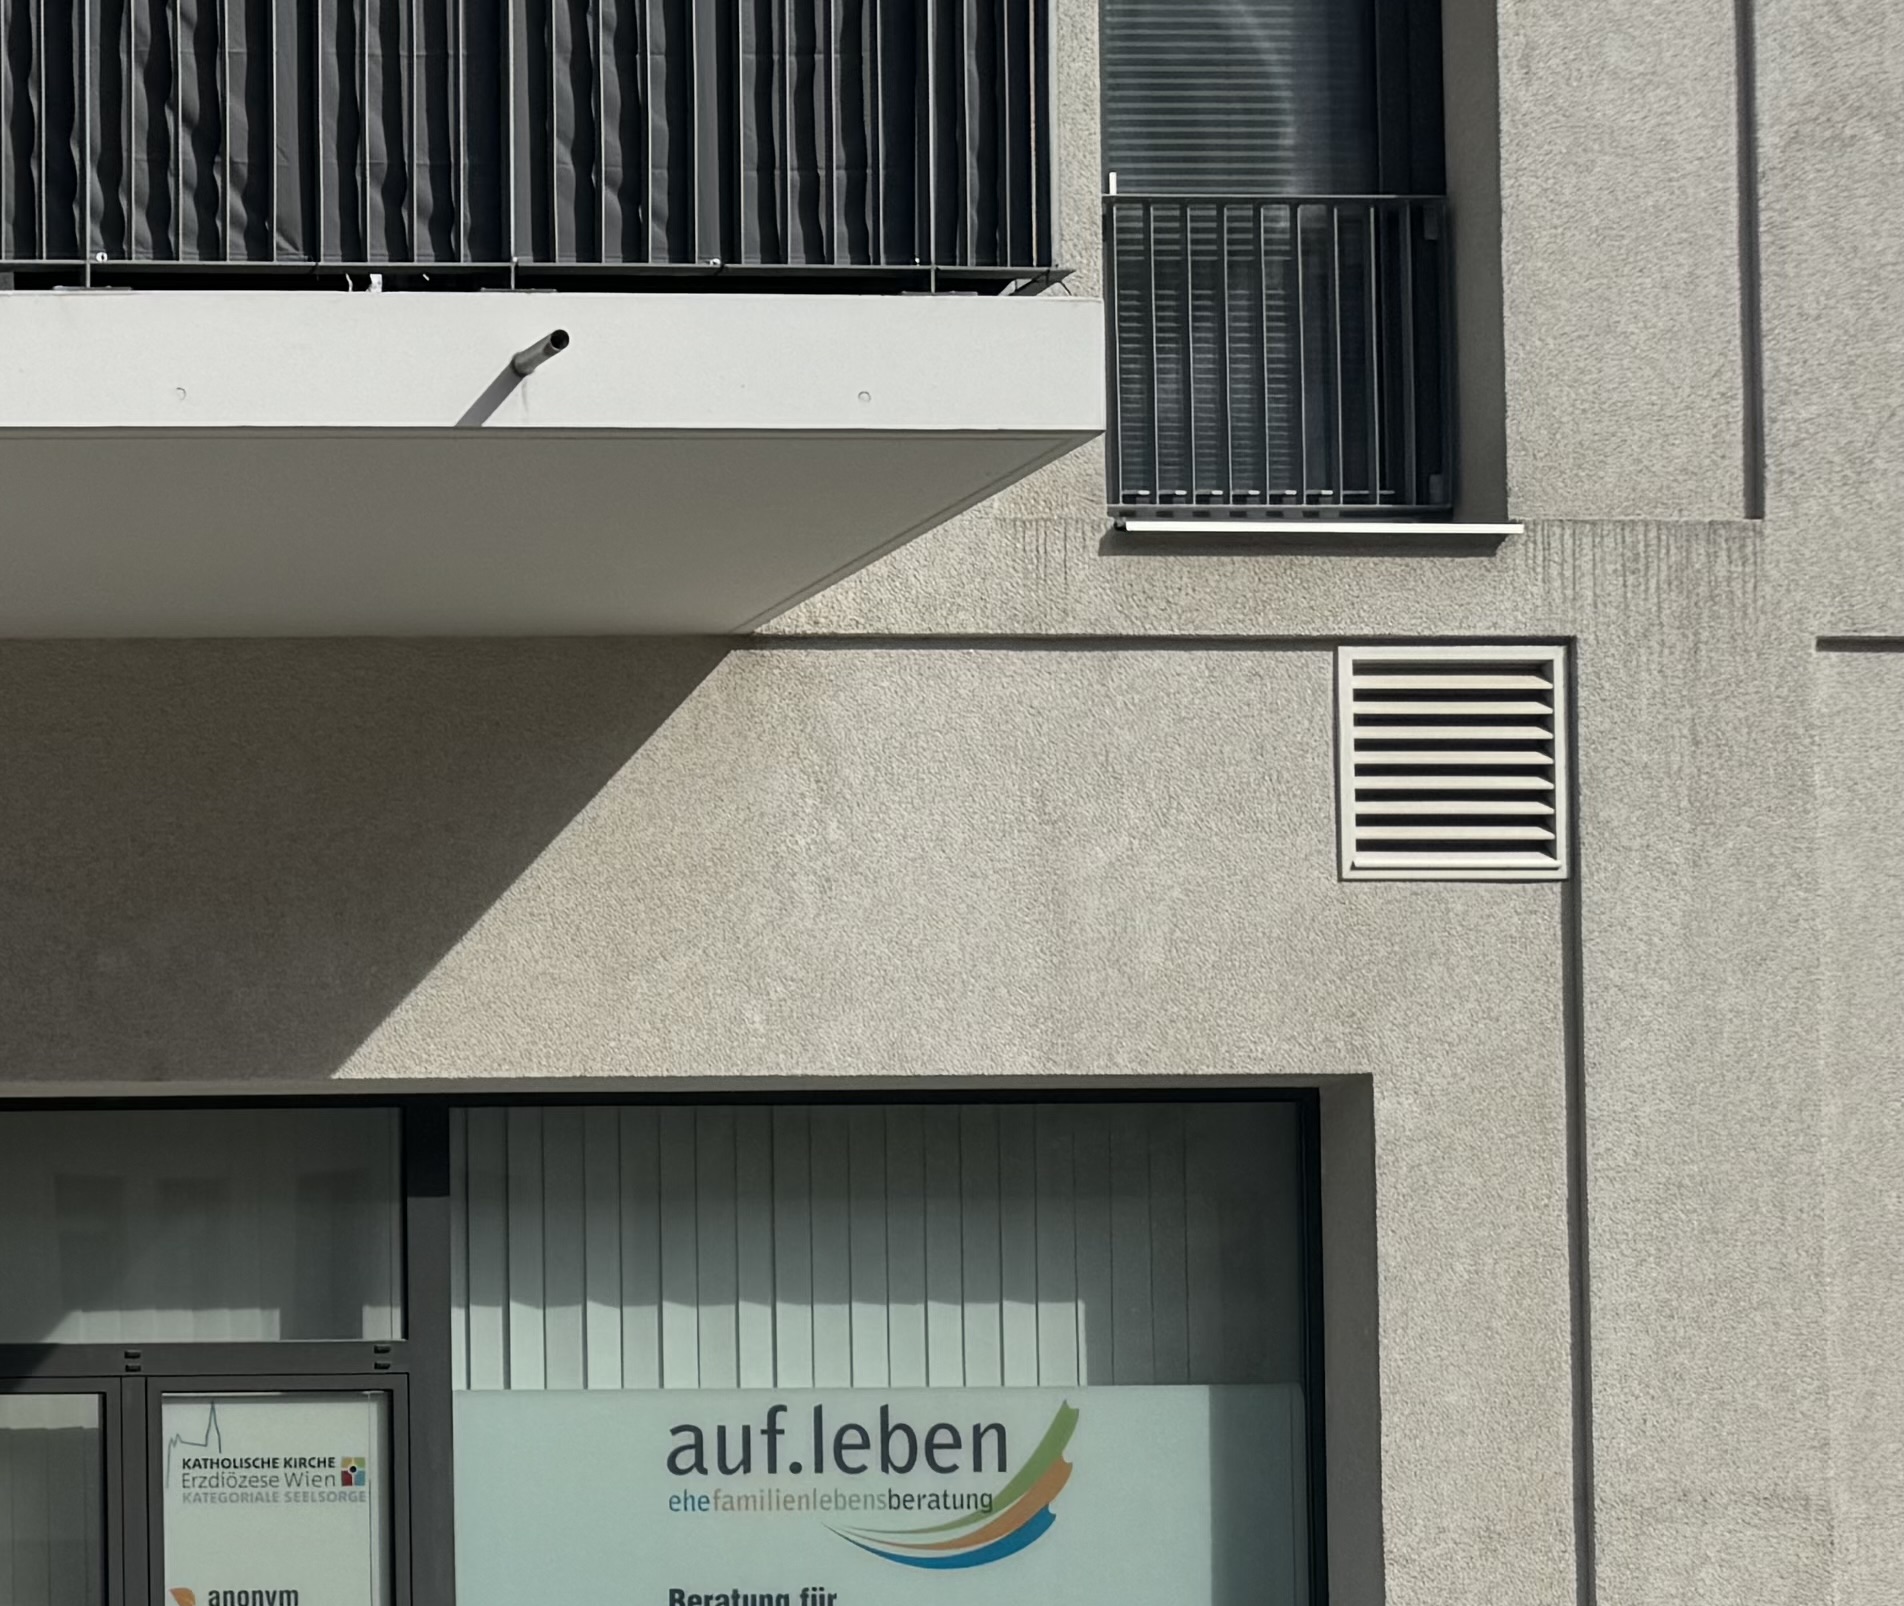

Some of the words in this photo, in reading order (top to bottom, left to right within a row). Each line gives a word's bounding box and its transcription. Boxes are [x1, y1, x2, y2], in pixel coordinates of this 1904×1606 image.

[666, 1403, 1009, 1476] auf.leben
[182, 1456, 280, 1469] KATHOLISCHE
[283, 1456, 336, 1469] KIRCHE
[182, 1471, 280, 1489] Erzdiözese
[284, 1471, 336, 1488] Wien
[182, 1491, 279, 1504] KATEGORIALE
[284, 1490, 367, 1503] SEELSORGE
[668, 1487, 994, 1514] ehefamilienlebensberatung
